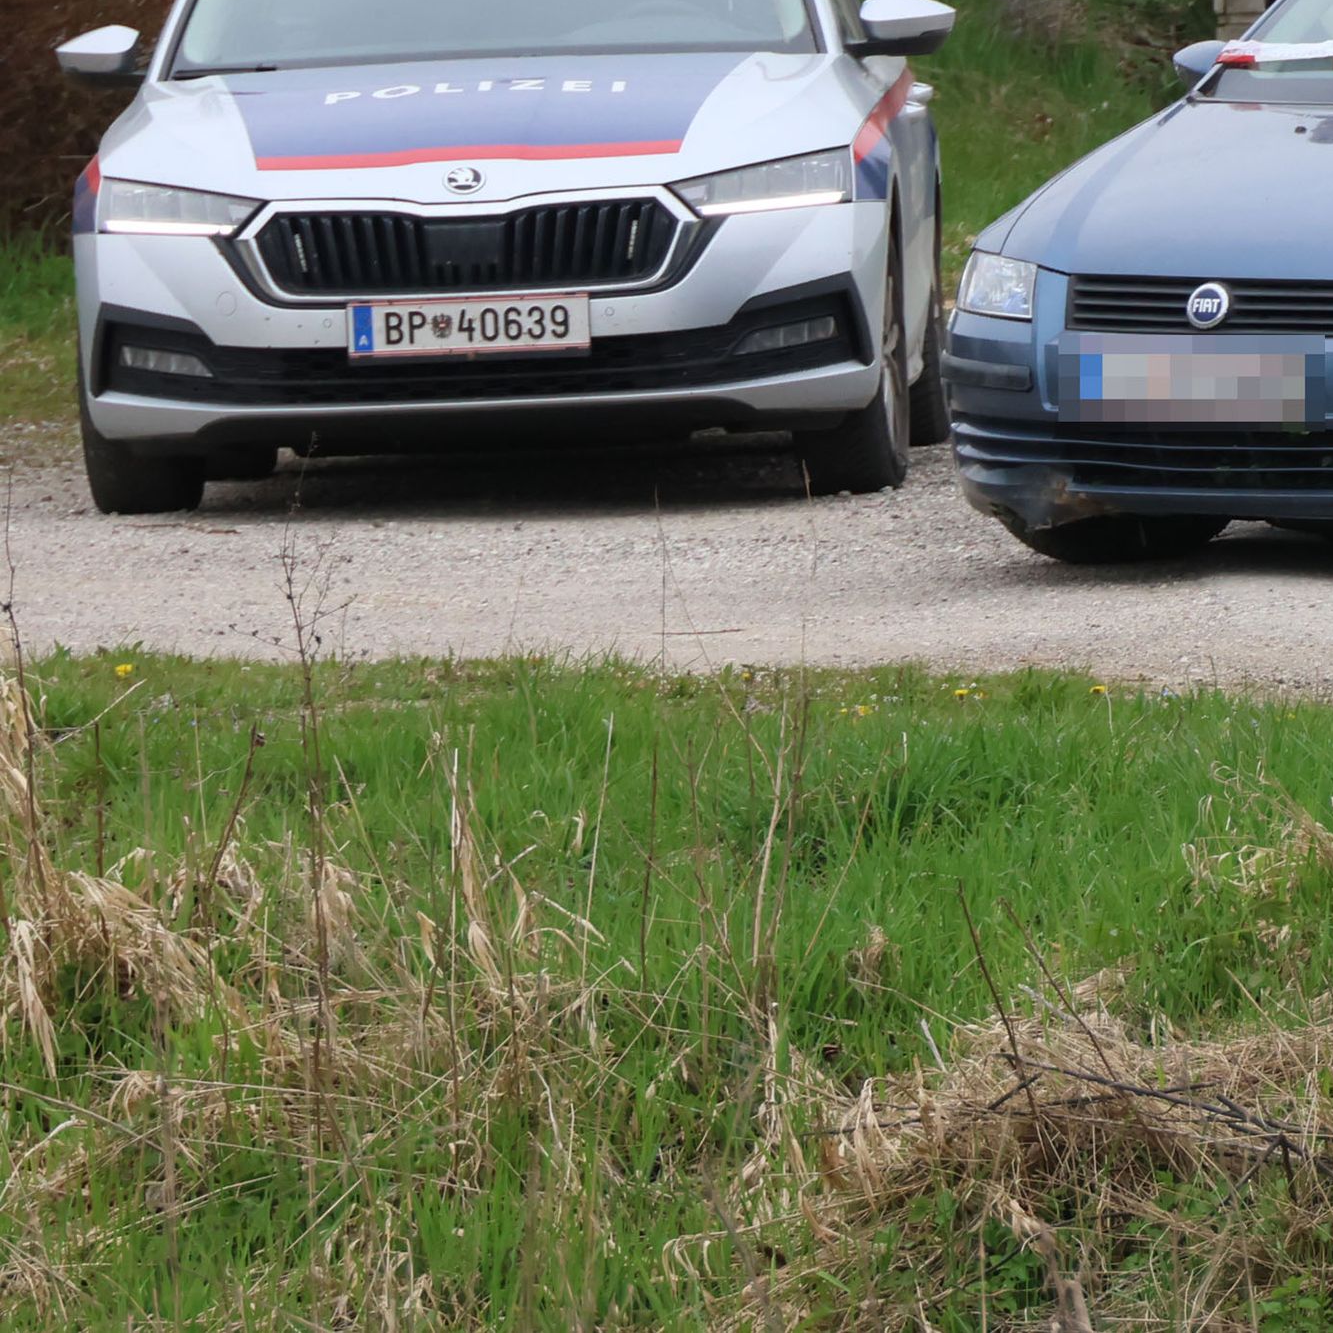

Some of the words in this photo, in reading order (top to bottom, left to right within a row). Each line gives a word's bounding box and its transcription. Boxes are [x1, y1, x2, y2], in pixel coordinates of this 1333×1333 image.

[324, 79, 627, 105] POLIZEI
[1192, 298, 1220, 313] FIAT
[358, 334, 369, 346] A
[384, 310, 427, 346] BP
[457, 304, 570, 343] 40639
